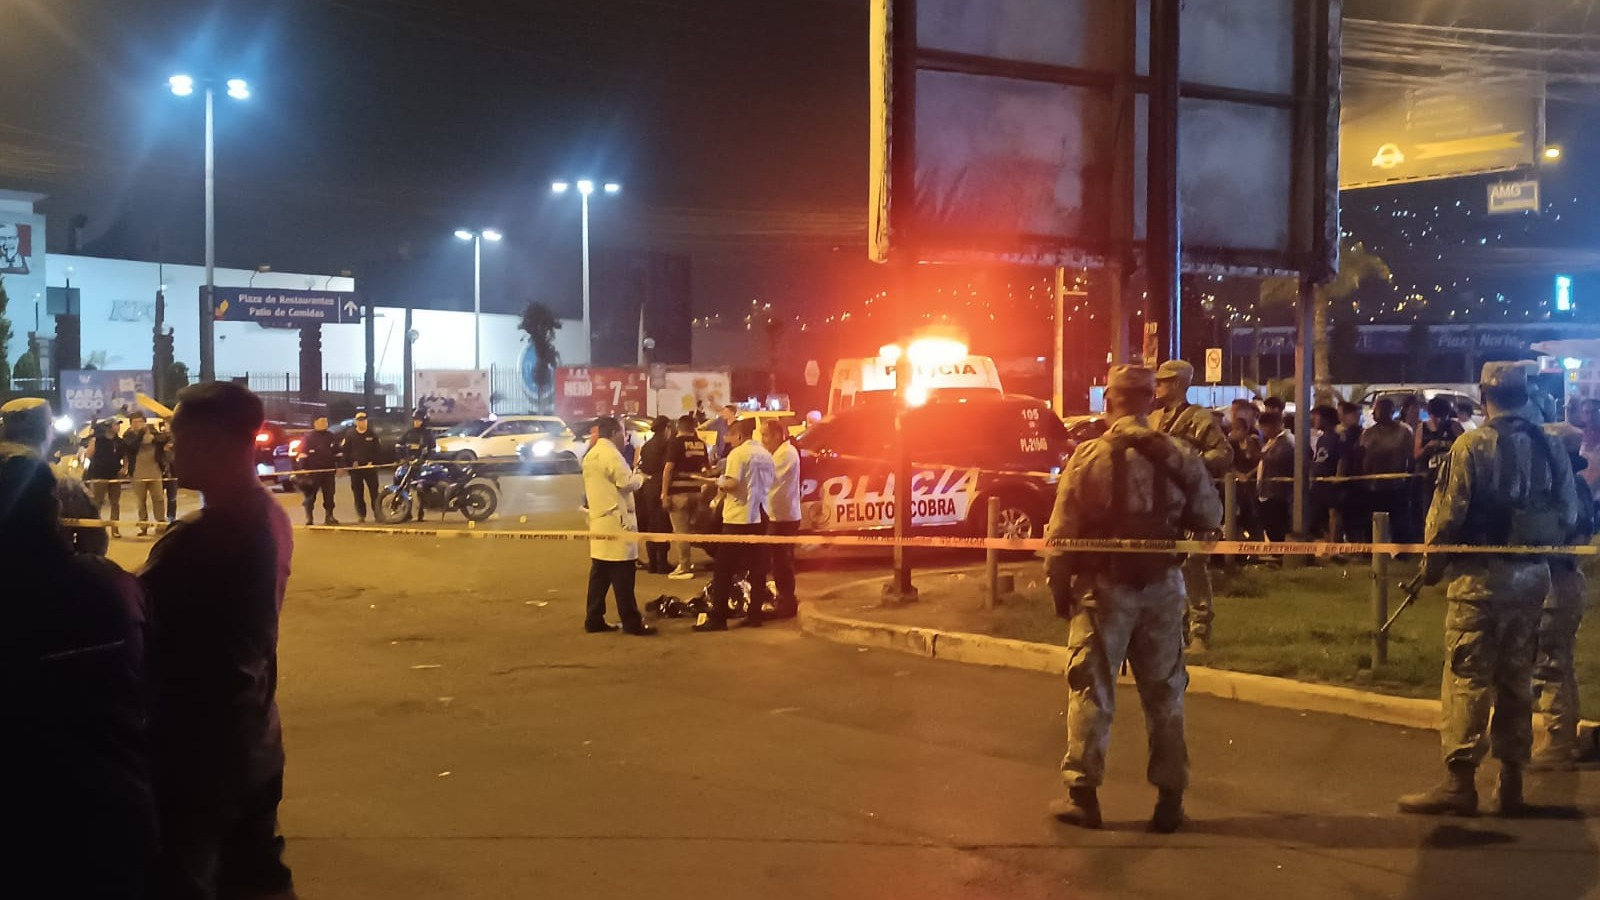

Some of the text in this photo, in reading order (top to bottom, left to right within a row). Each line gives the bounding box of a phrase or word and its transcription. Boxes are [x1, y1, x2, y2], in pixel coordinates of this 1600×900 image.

[1491, 183, 1521, 197] AMG
[238, 293, 335, 306] Plaza de Restaurantes
[249, 307, 325, 318] Patio de Comidas
[65, 389, 104, 401] PARA
[609, 380, 622, 406] 7
[66, 400, 104, 409] TODO
[1021, 408, 1040, 420] 105
[836, 498, 956, 523] PELOTO COBRA
